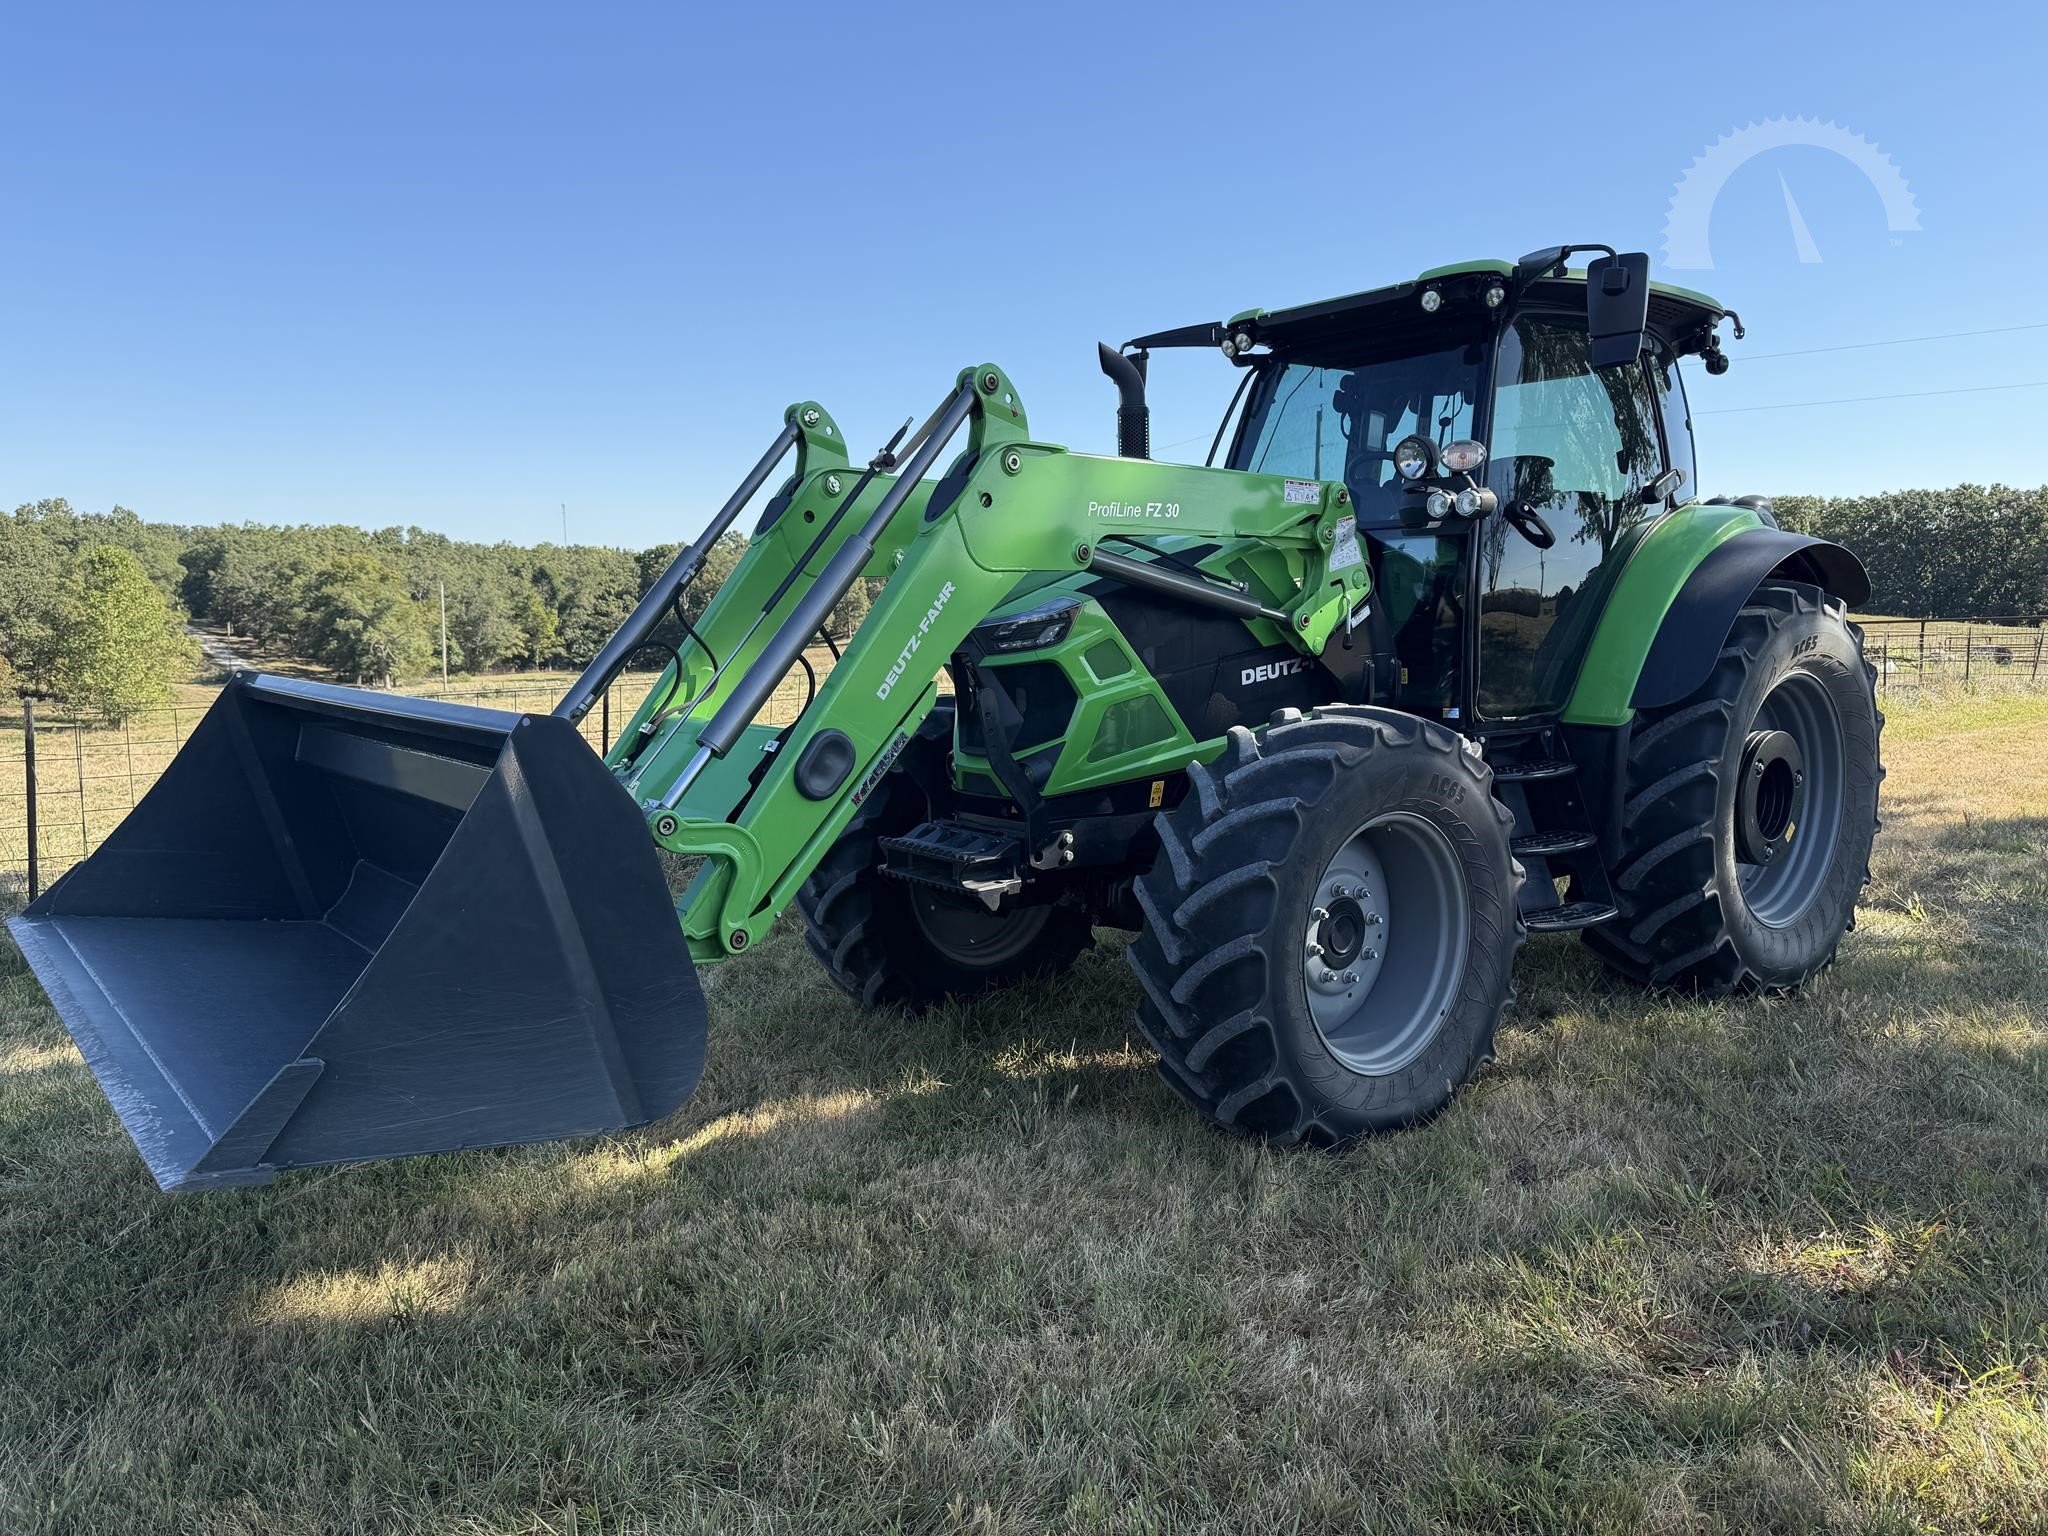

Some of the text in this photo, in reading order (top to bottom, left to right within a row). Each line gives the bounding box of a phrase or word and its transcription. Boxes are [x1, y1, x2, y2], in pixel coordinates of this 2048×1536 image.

[1087, 501, 1180, 518] ProfiLine FZ 30
[876, 581, 956, 701] DEUTZ-FAHR
[1791, 633, 1819, 661] AC65
[1429, 772, 1467, 806] AC65
